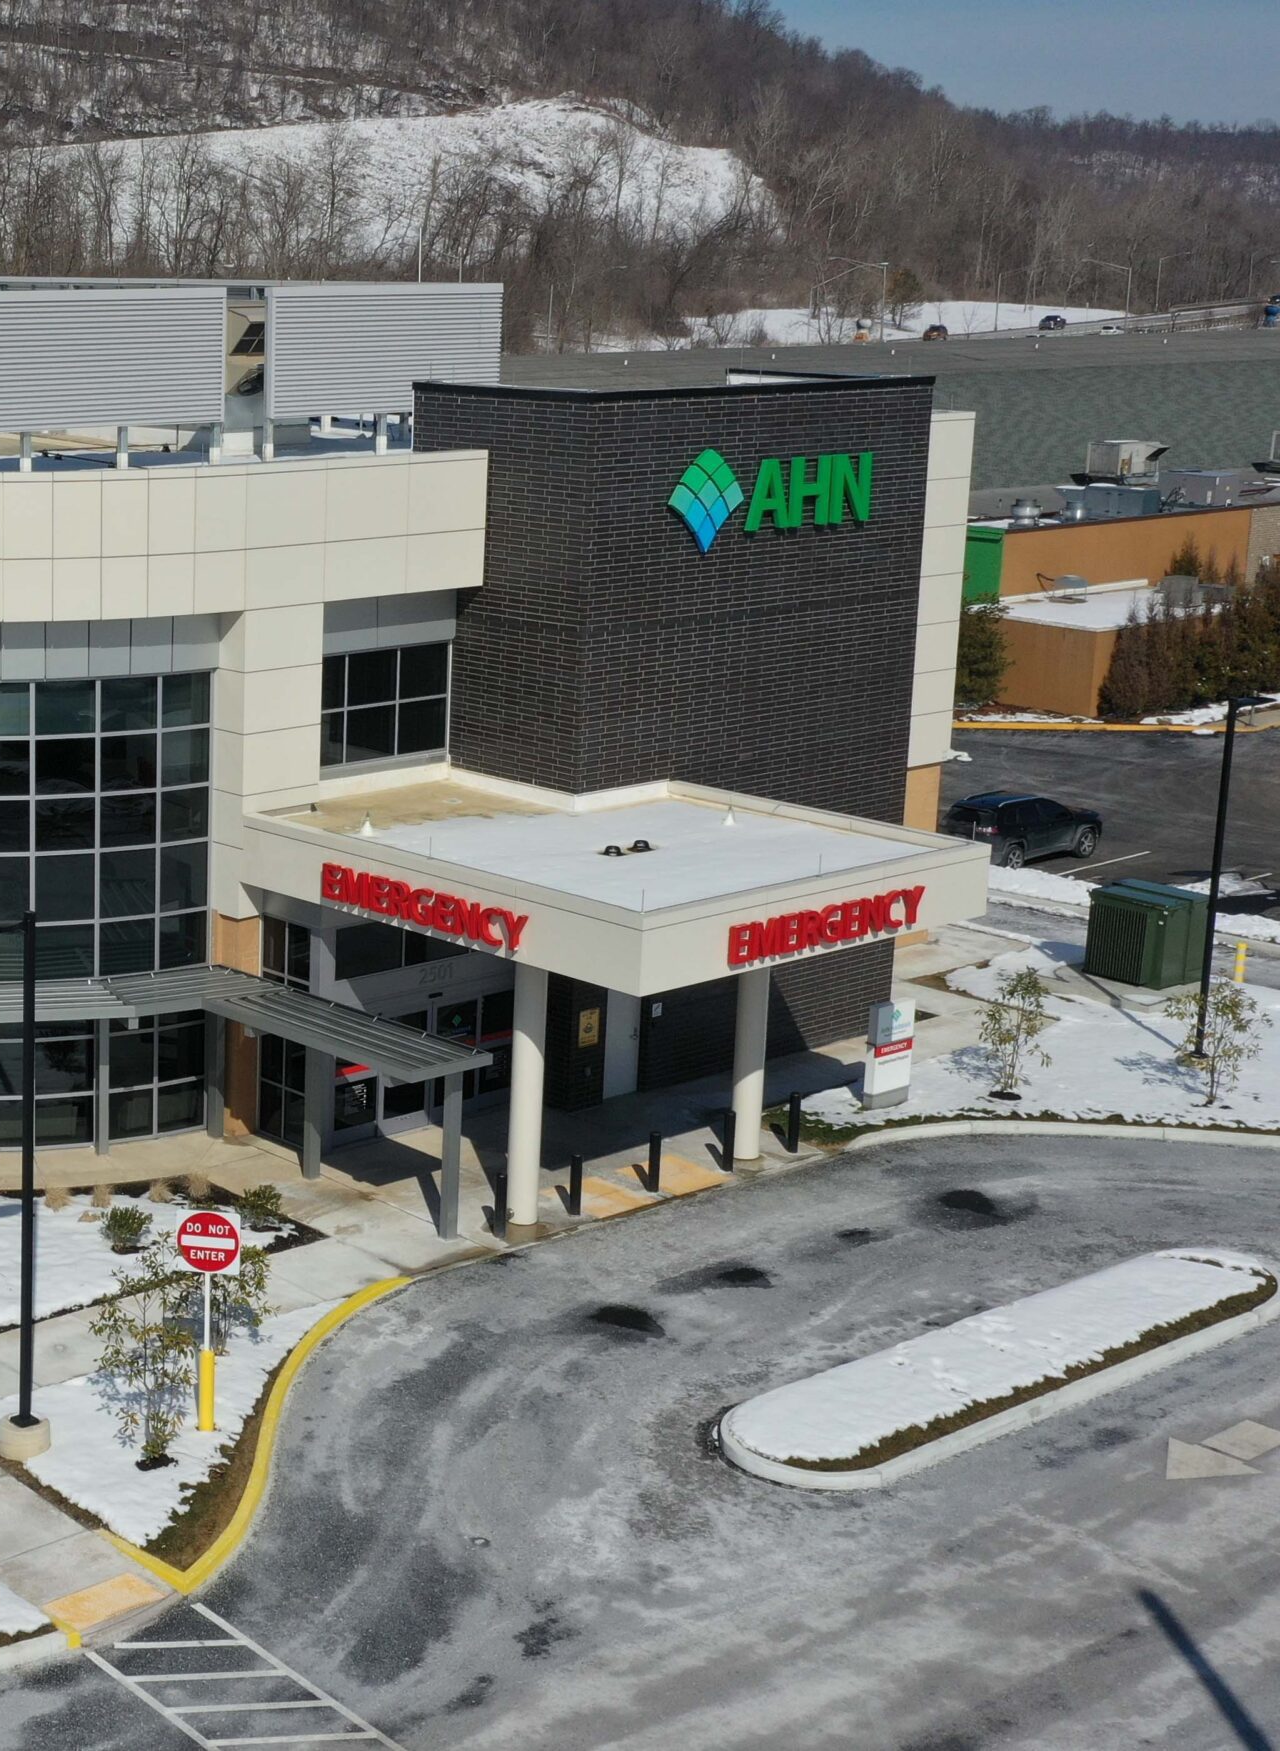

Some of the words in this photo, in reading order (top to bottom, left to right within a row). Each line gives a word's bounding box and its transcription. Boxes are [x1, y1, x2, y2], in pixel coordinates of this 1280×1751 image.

[743, 452, 873, 531] AHN
[322, 862, 529, 951] EMERGENCY
[727, 885, 926, 965] EMERGENCY
[186, 1222, 202, 1233] DO
[208, 1224, 231, 1236] NOT
[190, 1249, 225, 1262] ENTER
